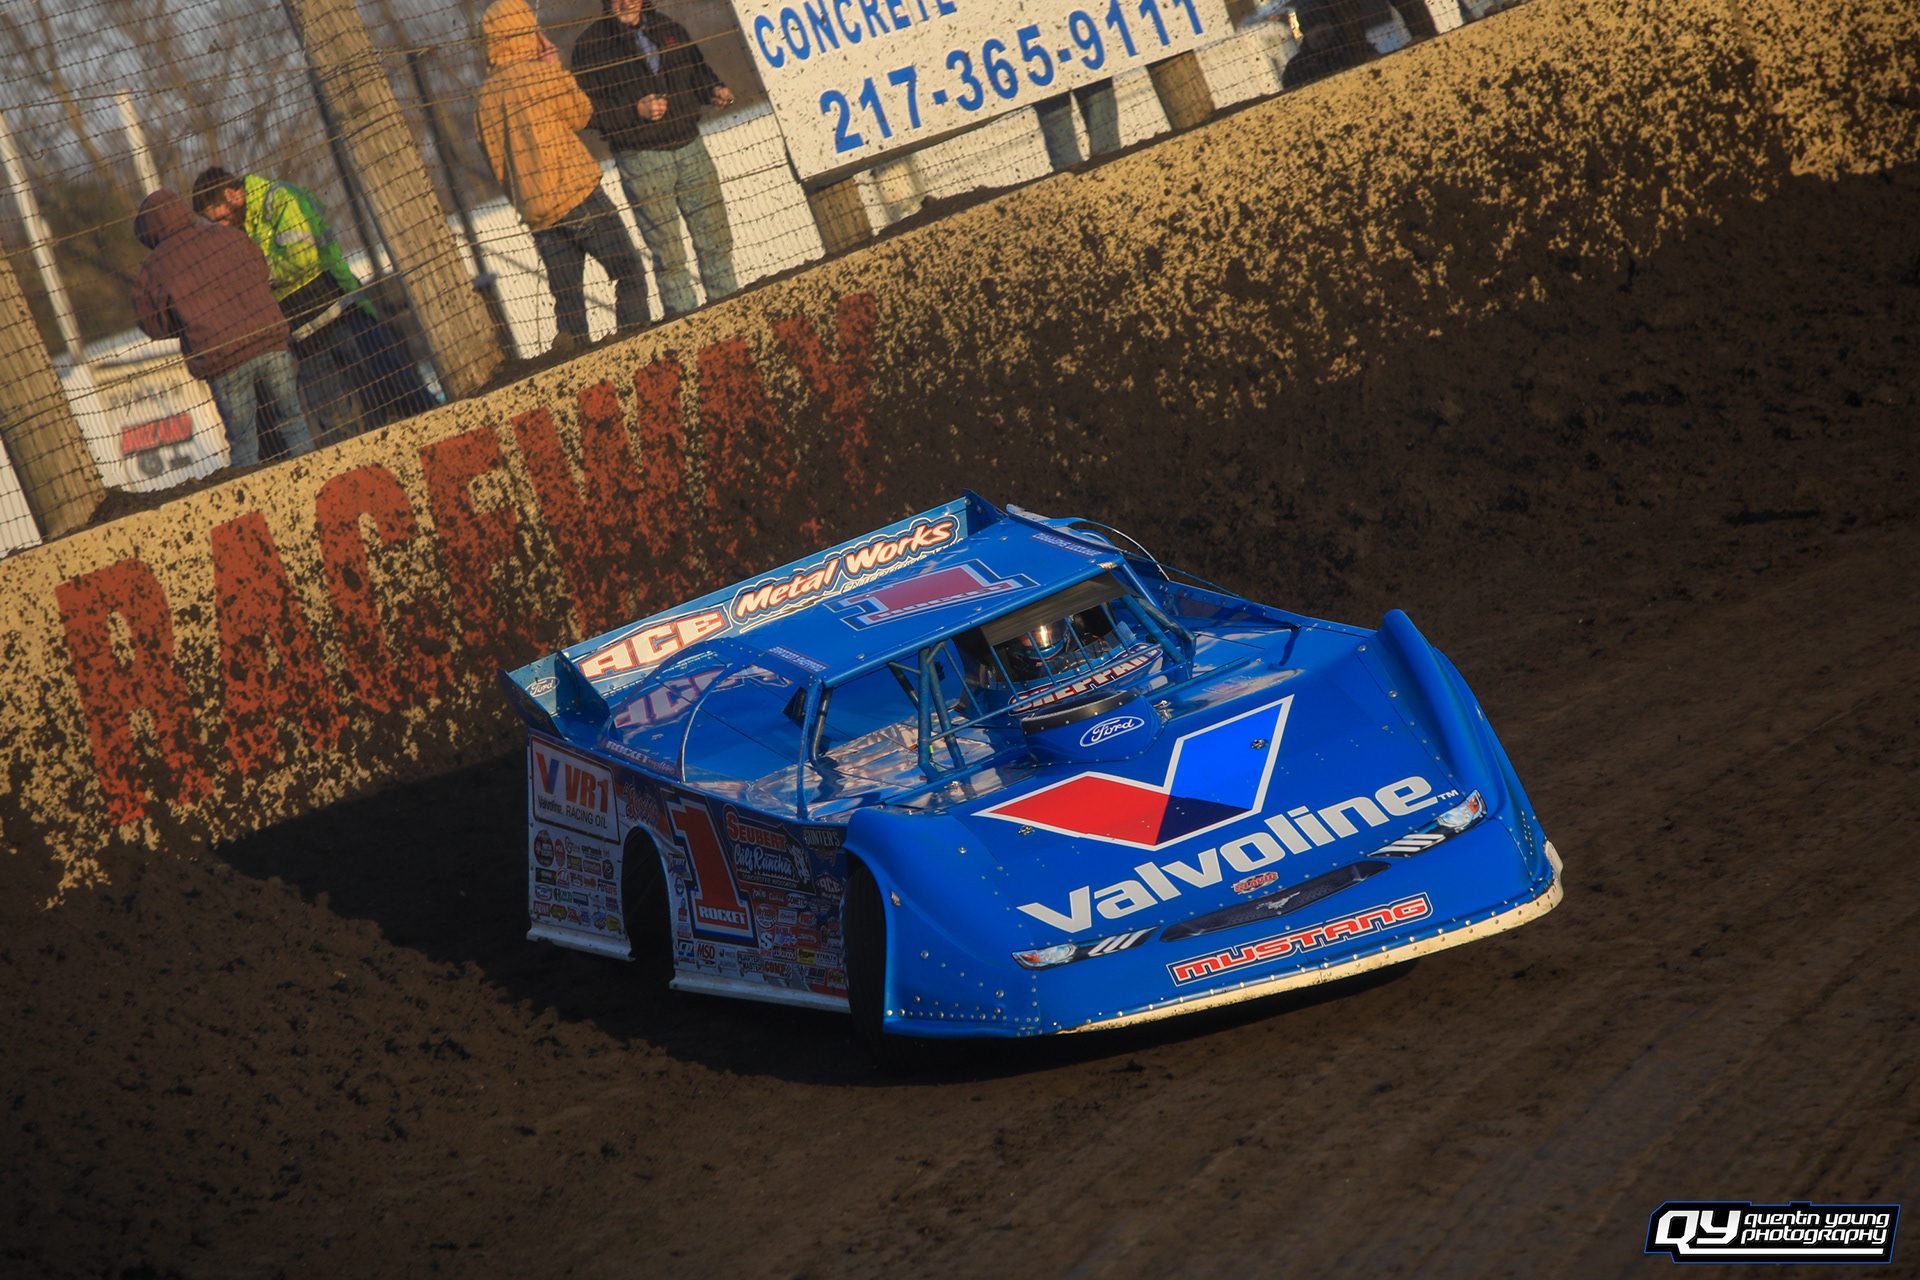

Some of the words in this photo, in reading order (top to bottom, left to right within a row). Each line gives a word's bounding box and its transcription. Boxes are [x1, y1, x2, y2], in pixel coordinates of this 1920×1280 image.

[820, 0, 1203, 153] 217-365-9111
[579, 610, 726, 679] ACE
[736, 558, 841, 619] Metal
[844, 521, 954, 575] Works
[530, 680, 555, 696] Ford
[1090, 718, 1135, 742] Ford
[606, 740, 649, 764] ROCKET
[565, 763, 609, 814] VR1
[566, 805, 593, 825] RACING
[595, 815, 608, 829] OIL
[726, 811, 787, 852] SEUBERT
[1016, 776, 1438, 934] Valvoline
[820, 876, 841, 893] ACE
[698, 905, 746, 925] ROCKET
[698, 943, 716, 961] MSD
[1175, 897, 1429, 983] MUSTANG
